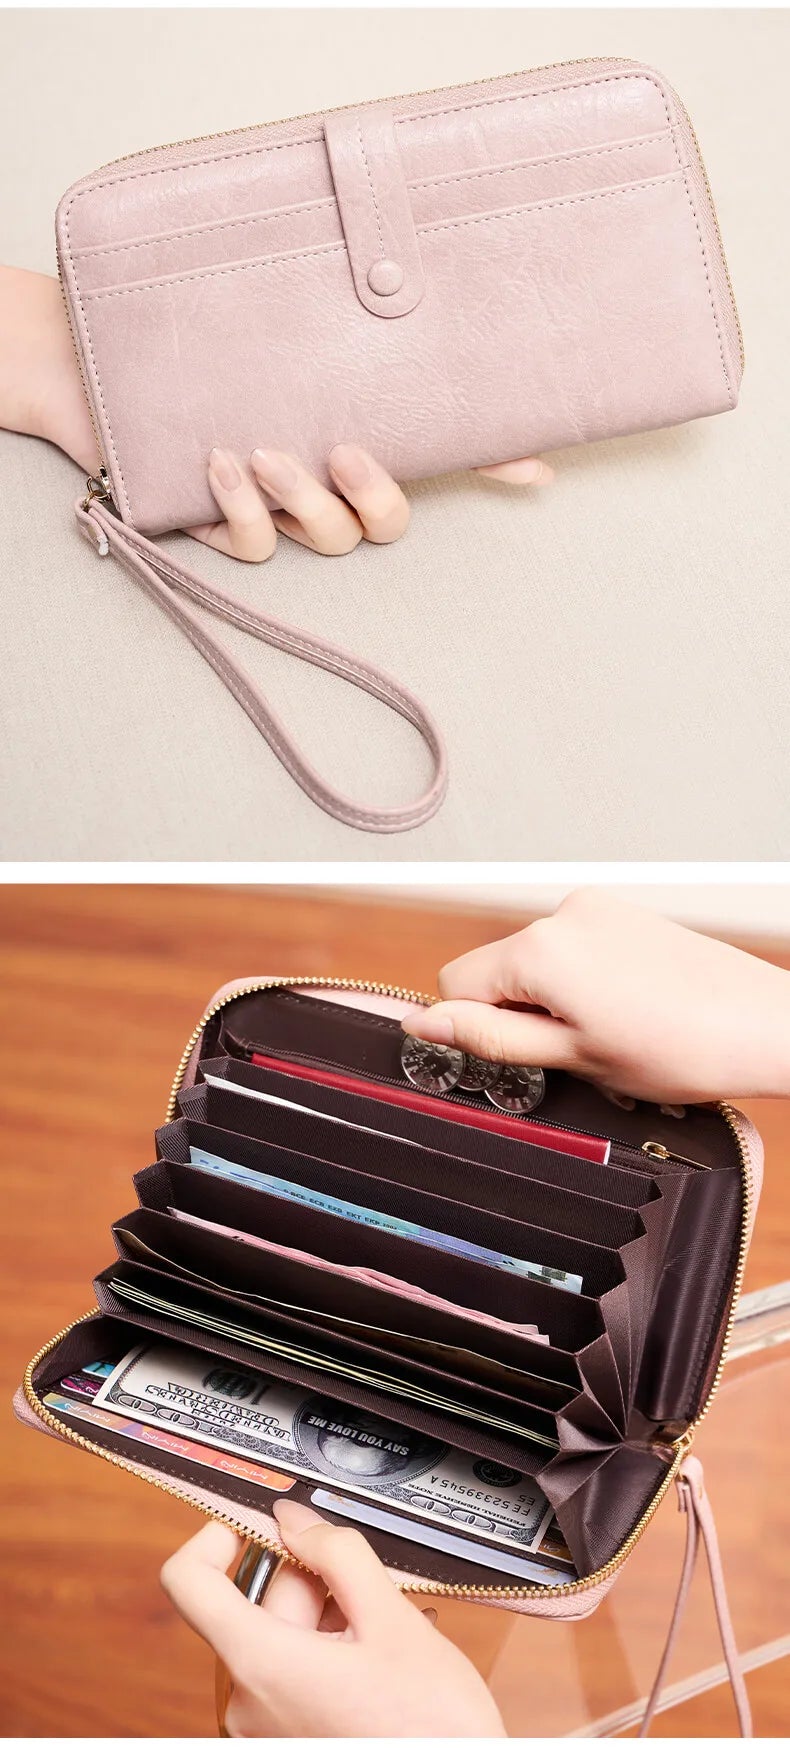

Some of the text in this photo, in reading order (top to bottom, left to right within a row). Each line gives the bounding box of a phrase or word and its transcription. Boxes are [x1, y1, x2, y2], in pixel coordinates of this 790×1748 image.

[346, 1211, 361, 1220] EKT
[364, 1217, 380, 1226] EKP
[145, 1385, 292, 1442] UNITED STATES
[167, 1382, 252, 1420] AMERICA
[307, 1415, 410, 1456] SAY YOU LOVE ME
[408, 1483, 433, 1495] NOTE
[430, 1475, 531, 1517] FE 52339545 A
[411, 1495, 515, 1538] 100
[481, 1508, 526, 1527] FEDERAL
